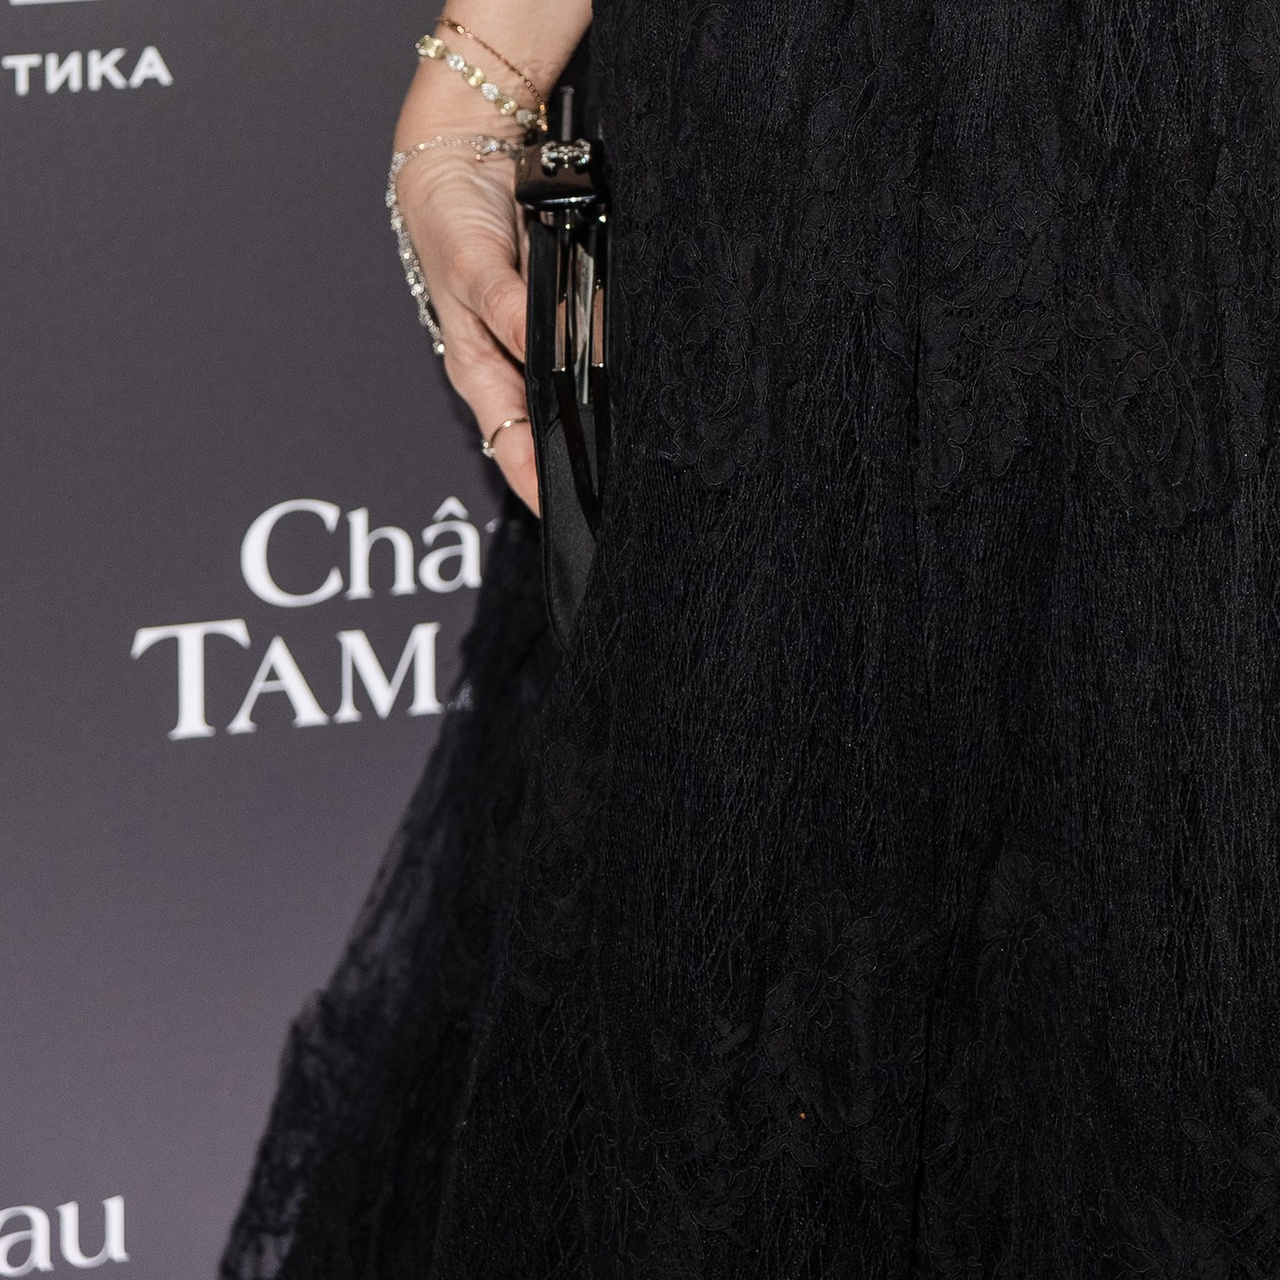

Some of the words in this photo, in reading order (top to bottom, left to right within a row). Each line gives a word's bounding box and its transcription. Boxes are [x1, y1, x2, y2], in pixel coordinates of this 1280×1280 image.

[1, 45, 174, 96] ТИКА
[240, 495, 498, 608] Châ
[130, 618, 472, 740] TAM
